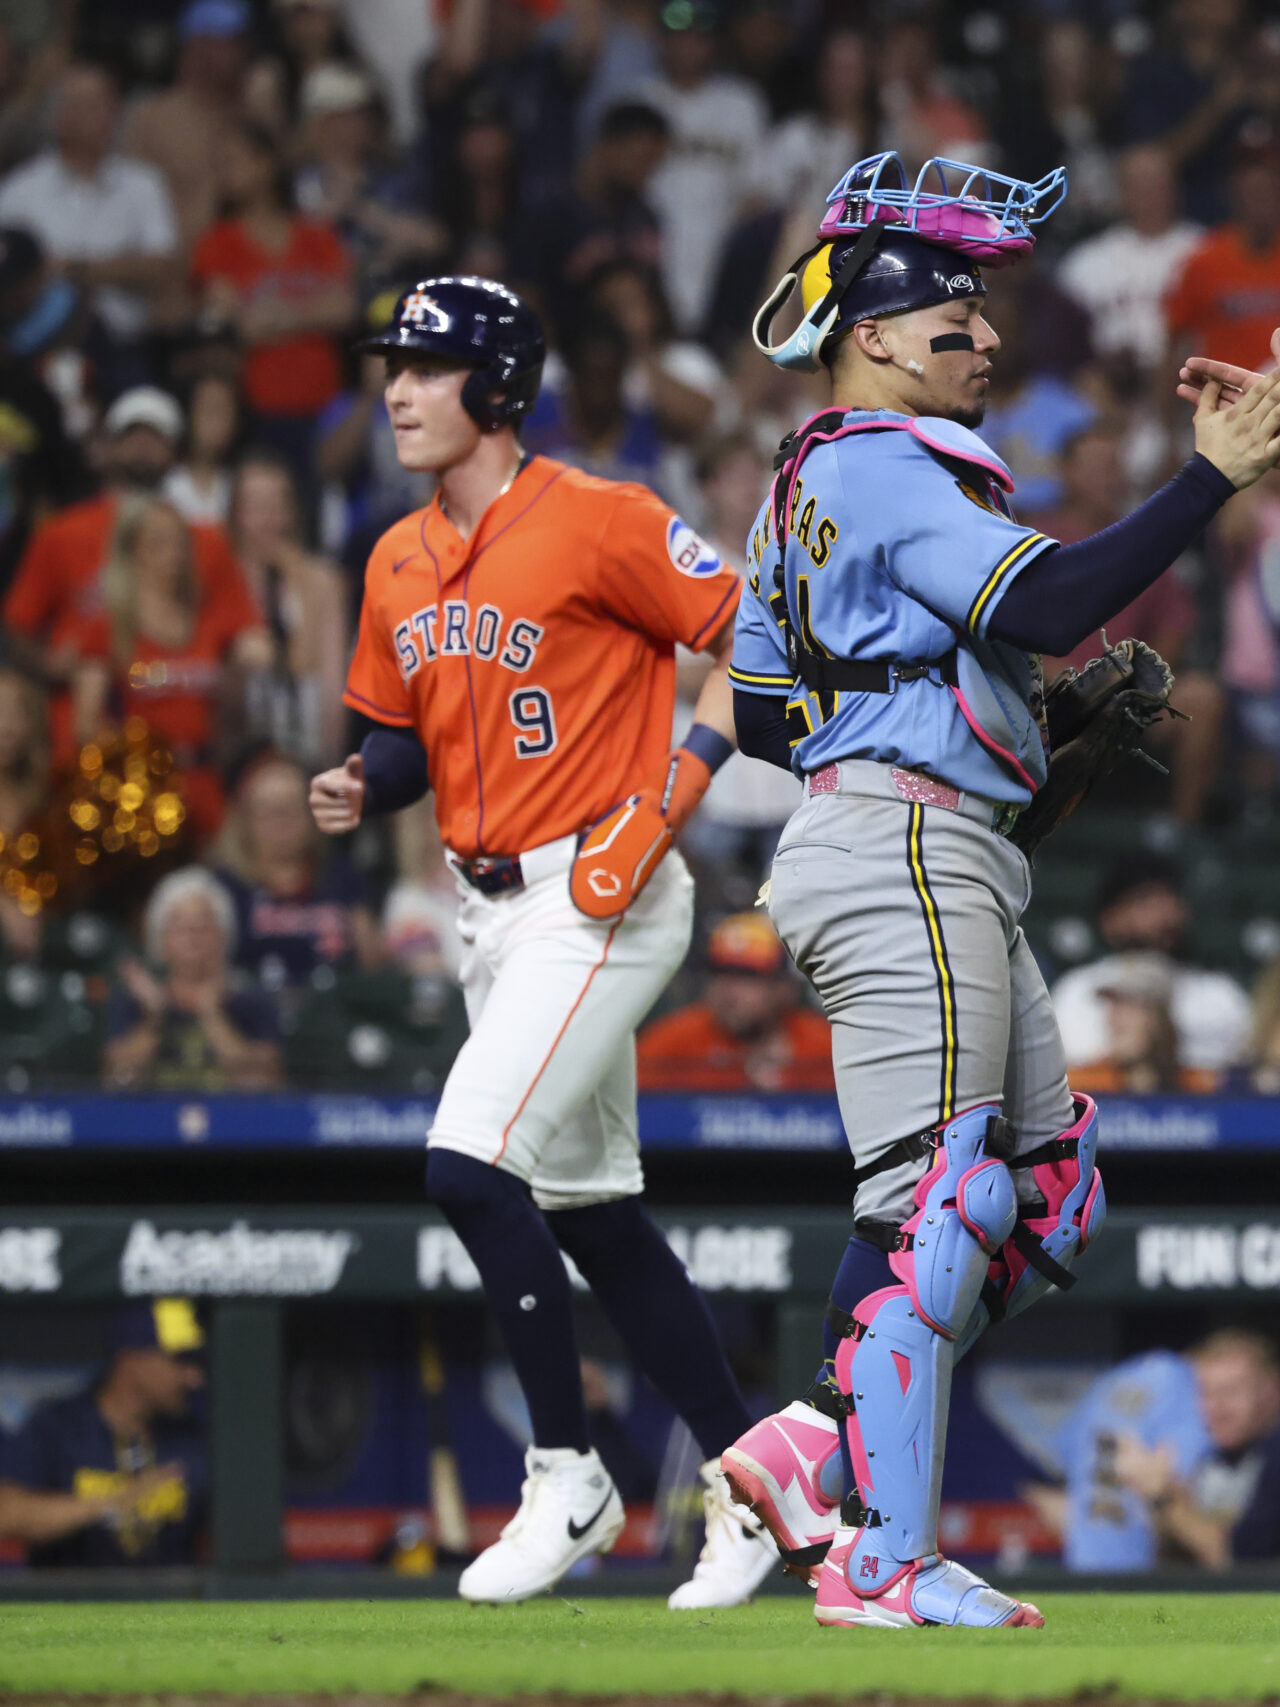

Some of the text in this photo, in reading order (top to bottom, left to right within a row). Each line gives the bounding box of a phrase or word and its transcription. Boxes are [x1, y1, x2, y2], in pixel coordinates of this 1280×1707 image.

[394, 600, 546, 684] STROS
[508, 685, 558, 760] 9
[119, 1219, 356, 1293] Academy
[418, 1225, 482, 1291] FU
[1137, 1224, 1237, 1290] FUN
[860, 1555, 879, 1579] 24
